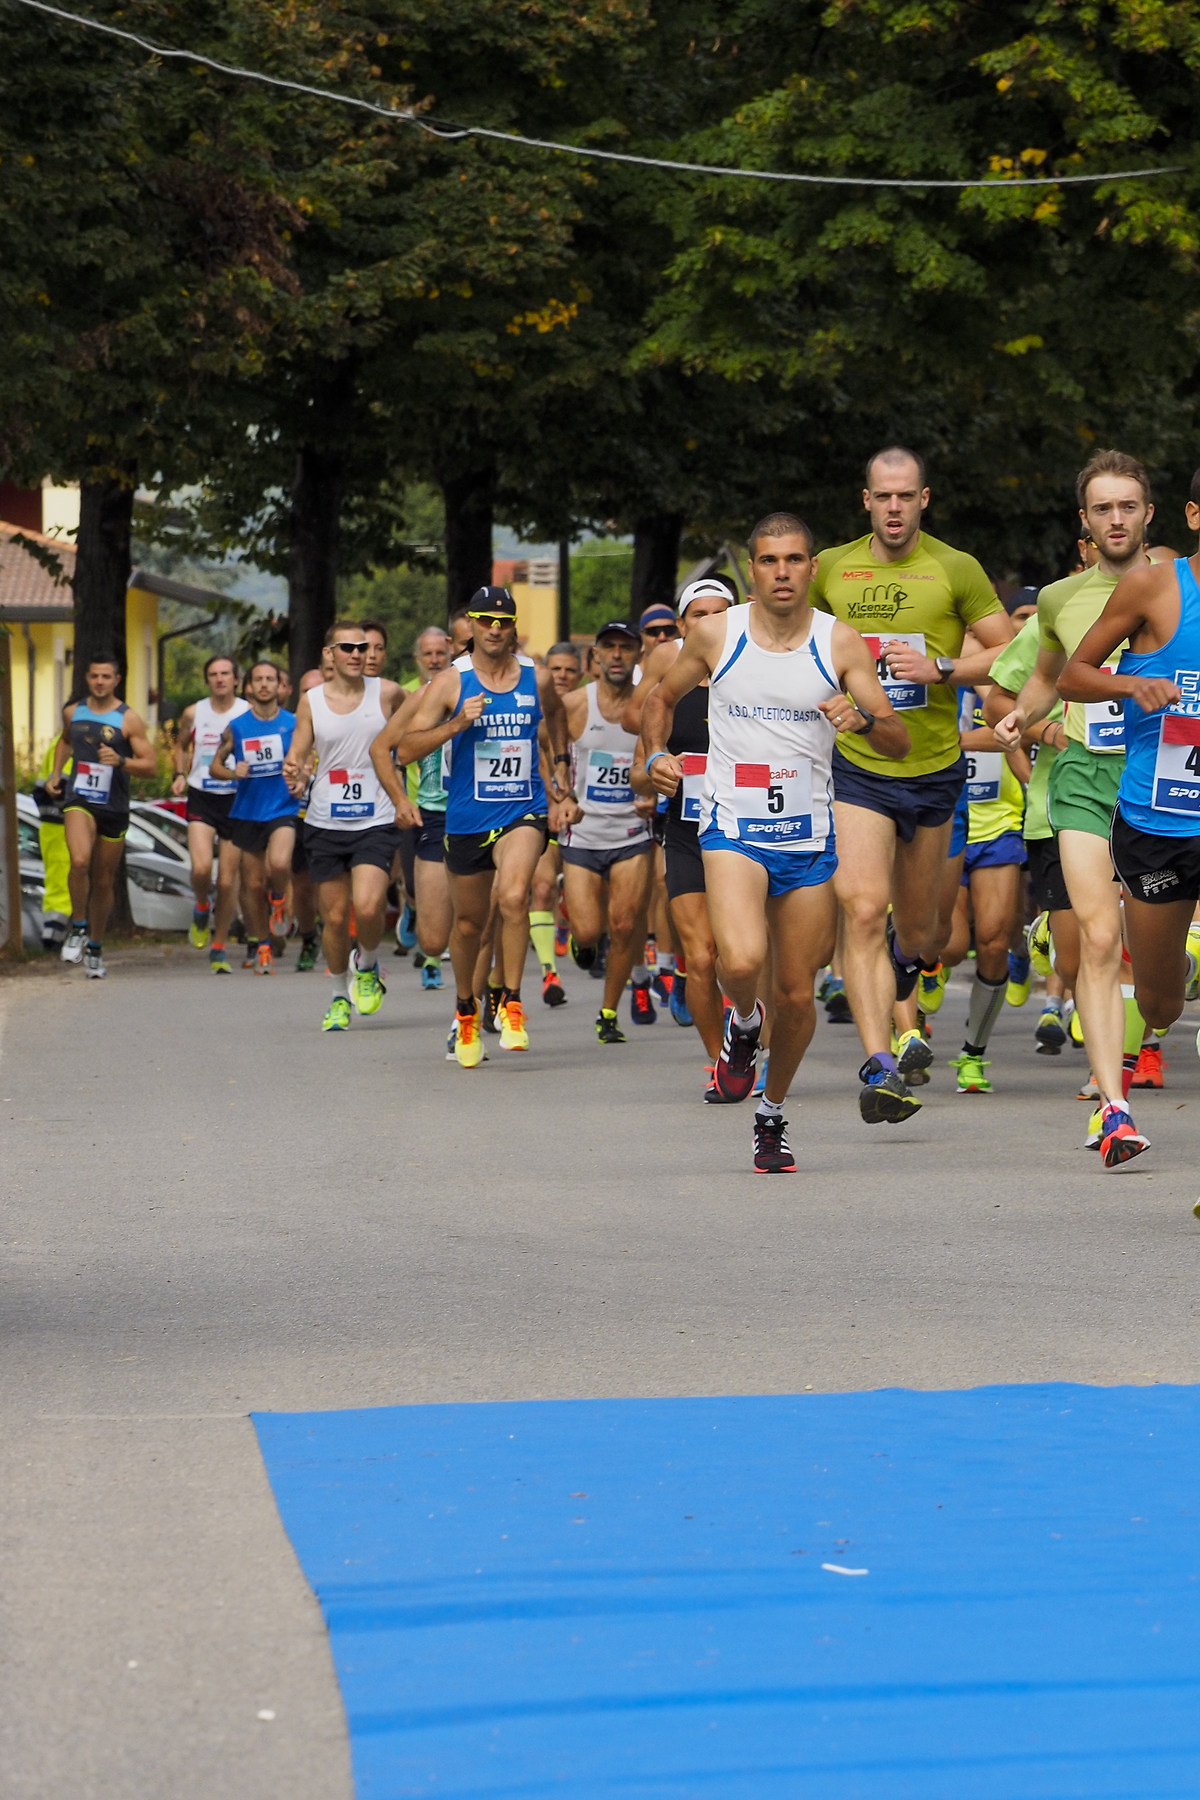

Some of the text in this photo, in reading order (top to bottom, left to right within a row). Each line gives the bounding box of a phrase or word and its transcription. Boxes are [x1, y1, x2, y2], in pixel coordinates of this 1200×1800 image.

[842, 571, 874, 579] MPS
[847, 602, 894, 613] Vicenza
[847, 611, 894, 619] Marathon
[728, 704, 821, 721] A.S.D. ATLETICO BASTIA
[473, 713, 531, 727] ATLETICA
[486, 725, 521, 738] MALO
[255, 747, 273, 761] 58
[489, 757, 522, 778] 247
[770, 768, 798, 780] caRun
[596, 766, 631, 786] 259
[342, 783, 363, 800] 29
[767, 785, 785, 814] 5
[747, 820, 802, 835] SPORTLER
